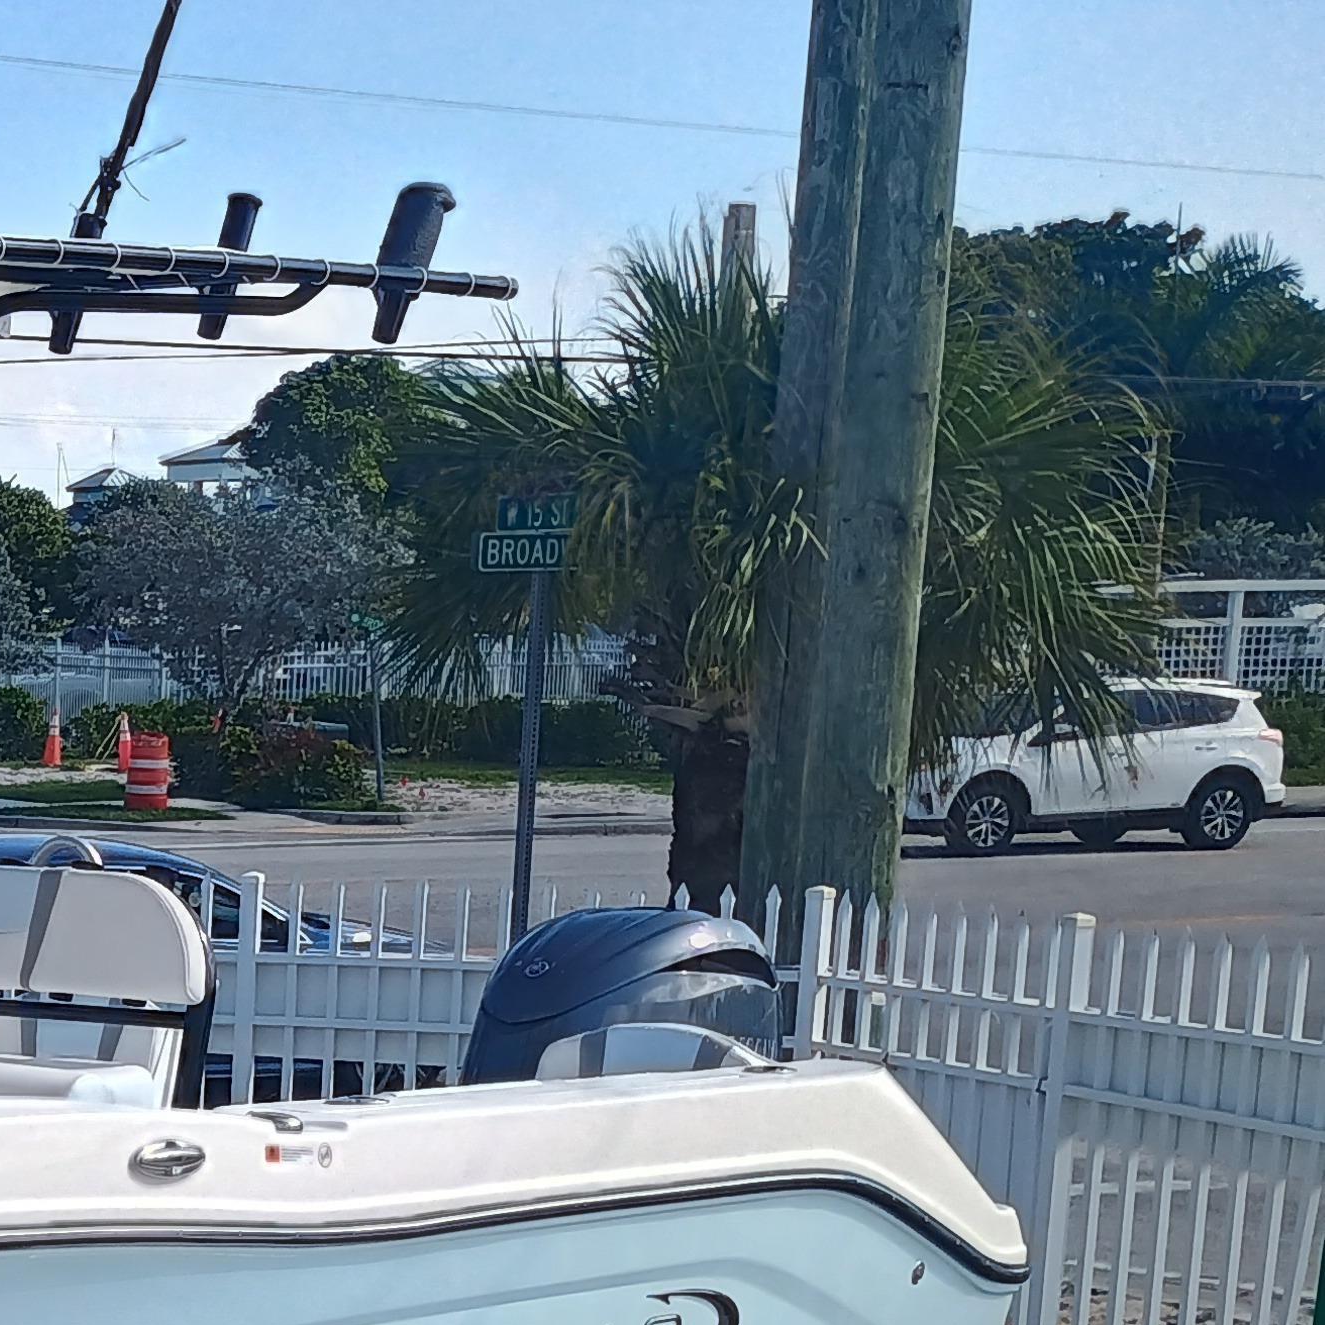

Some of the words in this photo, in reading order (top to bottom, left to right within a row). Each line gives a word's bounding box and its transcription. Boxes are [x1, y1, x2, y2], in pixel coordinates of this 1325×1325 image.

[527, 501, 543, 527] 15
[551, 498, 570, 526] ST
[486, 538, 566, 565] BROAD
